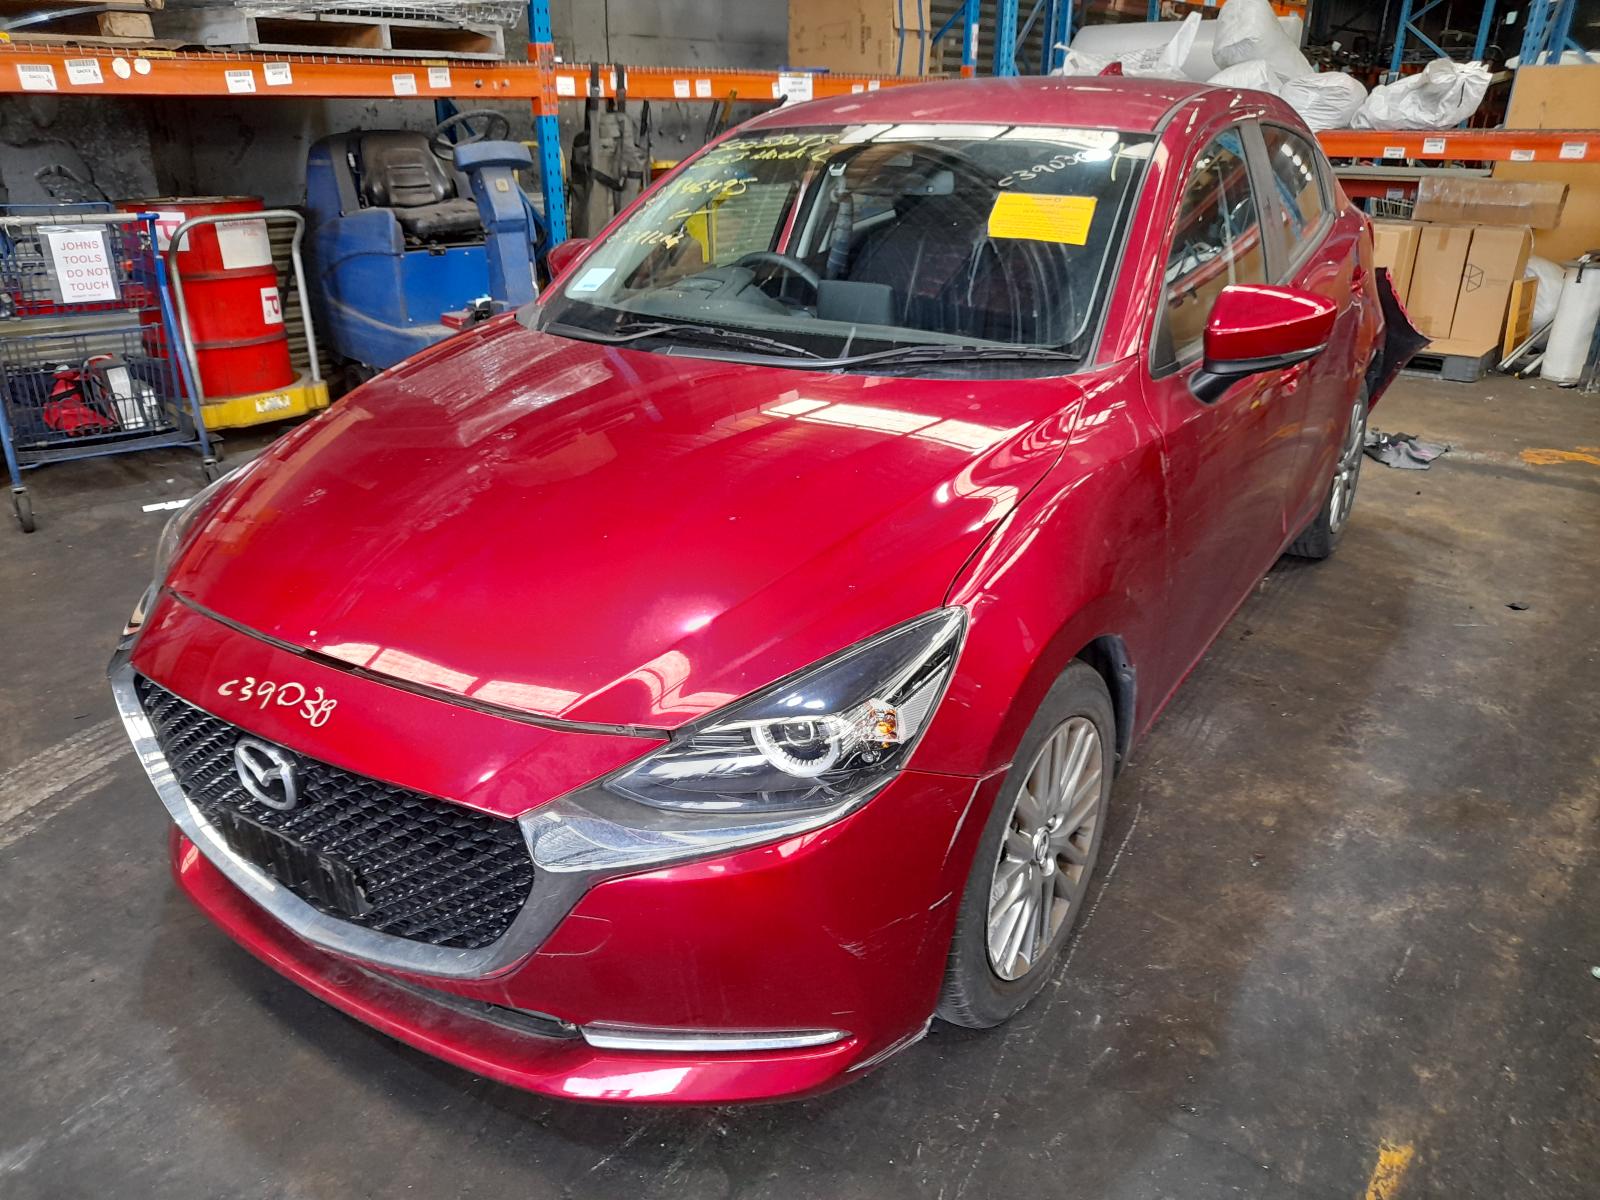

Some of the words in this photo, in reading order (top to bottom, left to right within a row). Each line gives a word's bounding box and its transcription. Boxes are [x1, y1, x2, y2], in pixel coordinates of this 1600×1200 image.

[61, 240, 99, 251] JOHNS
[63, 254, 102, 264] TOOLS
[66, 268, 84, 278] DO
[86, 266, 110, 277] NOT
[70, 280, 110, 291] TOUCH
